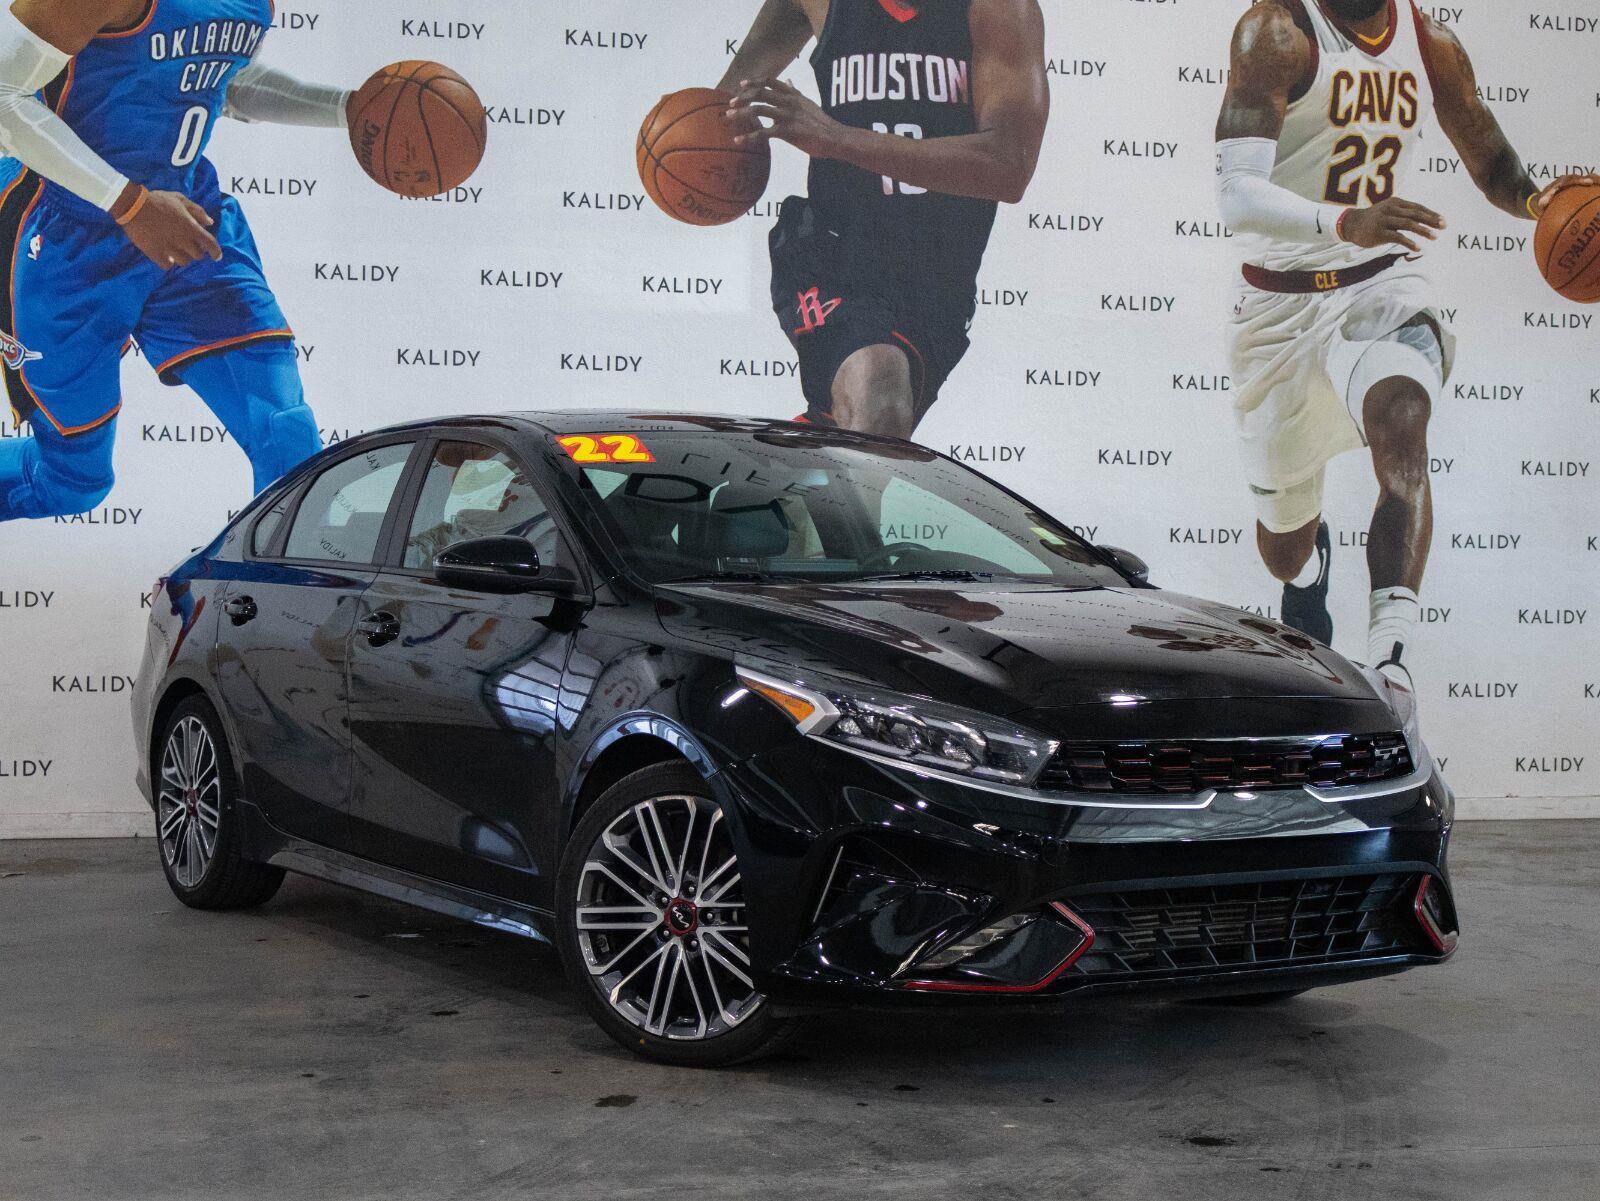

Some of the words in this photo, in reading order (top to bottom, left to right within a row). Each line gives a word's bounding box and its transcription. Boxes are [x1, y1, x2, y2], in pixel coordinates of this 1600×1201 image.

[282, 13, 319, 30] IDY
[1432, 7, 1463, 23] IDY
[1530, 14, 1598, 32] KALIDY
[402, 20, 484, 39] KALIDY
[151, 21, 262, 60] OKLAHOM
[566, 29, 647, 49] KALIDY
[1047, 59, 1106, 76] ALIDY
[1179, 67, 1230, 84] KALI
[180, 61, 231, 92] CITY
[831, 53, 968, 107] HOUSTON
[1328, 69, 1417, 129] CAVS
[1476, 86, 1529, 102] ALIDY
[484, 106, 565, 126] KALIDY
[171, 105, 209, 167] 0
[1104, 140, 1177, 158] KALIDY
[1324, 134, 1402, 206] 23
[1428, 157, 1460, 173] IDY
[231, 177, 317, 196] KALIDY
[563, 192, 645, 211] KALIDY
[1029, 214, 1103, 231] KALIDY
[1458, 234, 1526, 251] KALIDY
[315, 264, 399, 282] KALIDY
[481, 270, 563, 288] KALIDY
[1315, 272, 1339, 290] CLE
[643, 276, 722, 294] KALIDY
[982, 290, 1028, 306] LIDY
[1102, 295, 1175, 312] KALIDY
[1525, 312, 1592, 328] KALIDY
[398, 349, 480, 366] KALIDY
[561, 354, 642, 372] KALIDY
[721, 359, 799, 377] KALIDY
[1027, 369, 1101, 386] KALIDY
[1173, 374, 1229, 390] KALID
[1455, 384, 1523, 400] KALIDY
[143, 425, 228, 442] KALIDY
[559, 434, 648, 462] 22
[950, 445, 1025, 461] KALIDY
[1099, 449, 1172, 465] KALIDY
[1522, 461, 1589, 476] KALIDY
[886, 524, 948, 540] ALIDY
[1170, 528, 1242, 544] KALIDY
[1340, 531, 1368, 546] LID
[1452, 534, 1520, 549] KALIDY
[0, 591, 54, 607] LIDY
[1421, 608, 1451, 622] IDY
[1519, 609, 1586, 624] KALIDY
[53, 676, 135, 692] KALIDY
[1449, 683, 1517, 697] KALIDY
[0, 760, 52, 776] LIDY
[1516, 758, 1584, 772] KALIDY
